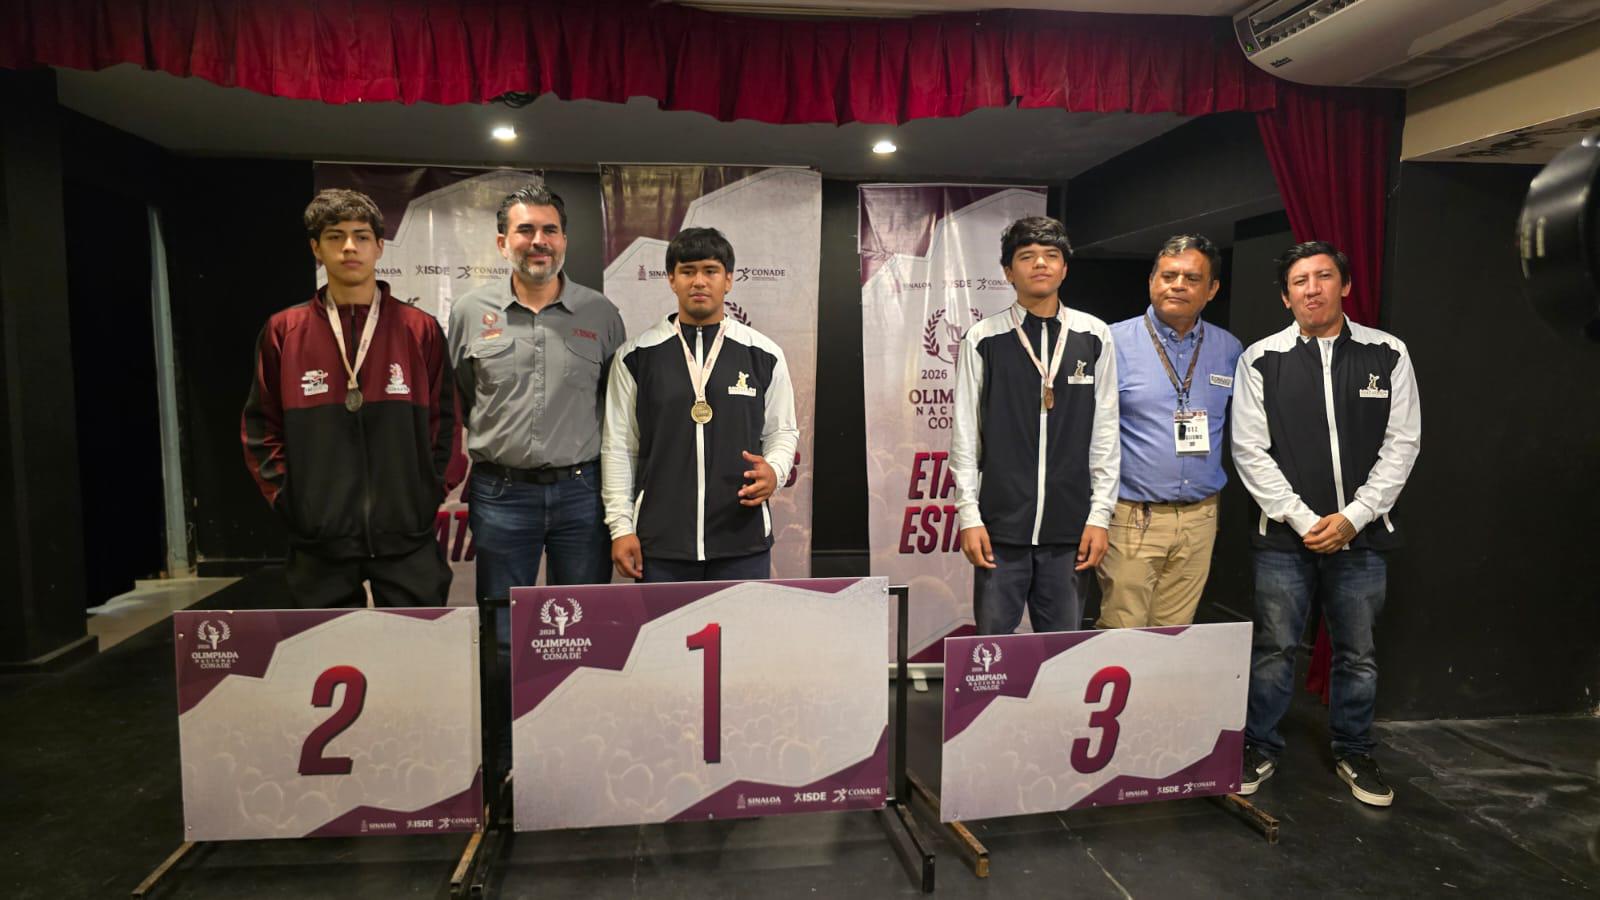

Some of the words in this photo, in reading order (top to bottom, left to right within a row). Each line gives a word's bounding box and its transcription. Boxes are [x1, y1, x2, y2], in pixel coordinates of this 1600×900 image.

[424, 266, 450, 275] ISDE
[474, 266, 509, 275] CONADE
[921, 369, 948, 380] 2026
[908, 388, 955, 405] OLIM
[916, 406, 954, 416] NAC
[898, 505, 961, 554] EST
[531, 638, 592, 648] OLIMPIADA
[191, 651, 239, 660] OLIMPIADA
[966, 673, 1007, 682] OLIMPIADA
[686, 622, 722, 765] 1
[298, 665, 367, 776] 2
[1070, 665, 1132, 775] 3
[847, 786, 882, 796] CONADE
[1162, 785, 1180, 794] ISDE
[747, 795, 782, 805] SINALOA
[802, 791, 827, 802] ISDE
[413, 819, 434, 828] ISDE
